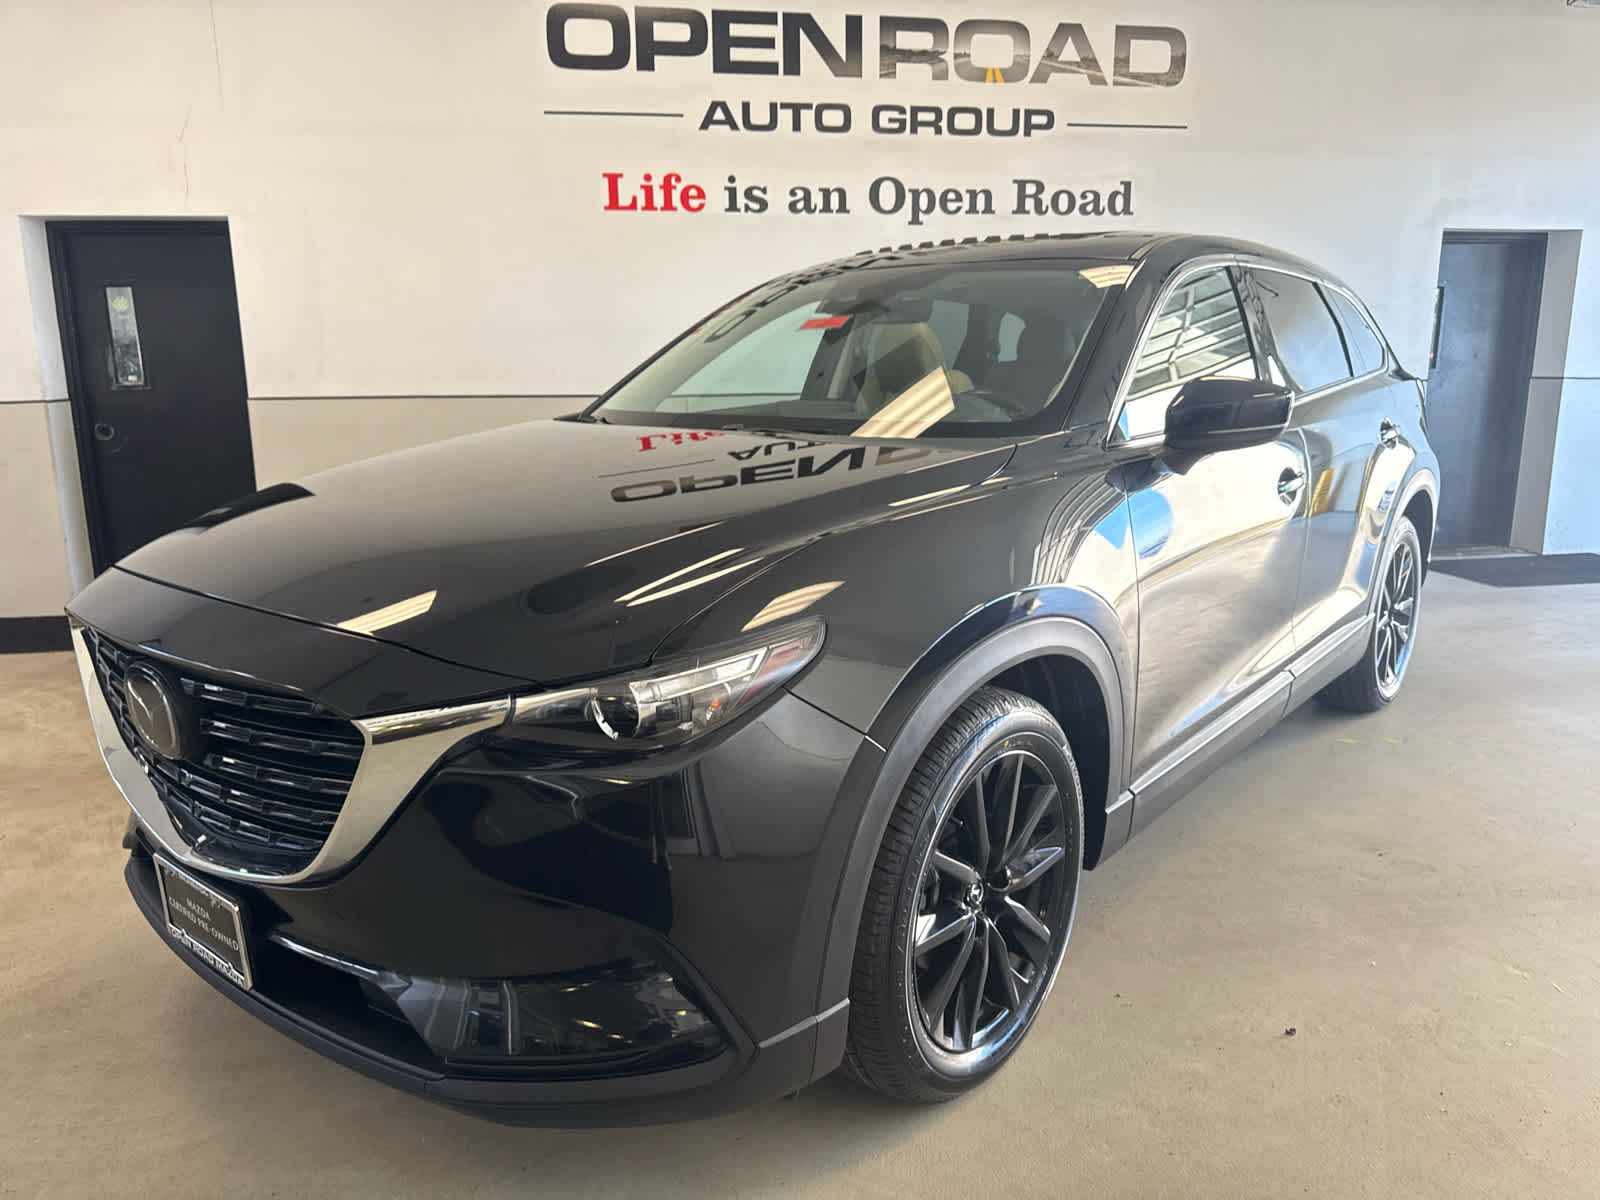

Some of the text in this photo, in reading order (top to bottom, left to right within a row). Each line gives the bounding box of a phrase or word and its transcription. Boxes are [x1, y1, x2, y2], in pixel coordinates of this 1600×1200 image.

[546, 2, 1187, 88] OPEN ROAD
[698, 100, 1056, 138] AUTO GROUP
[601, 172, 1134, 226] Life is an Open Road
[186, 897, 211, 921] MAZDA
